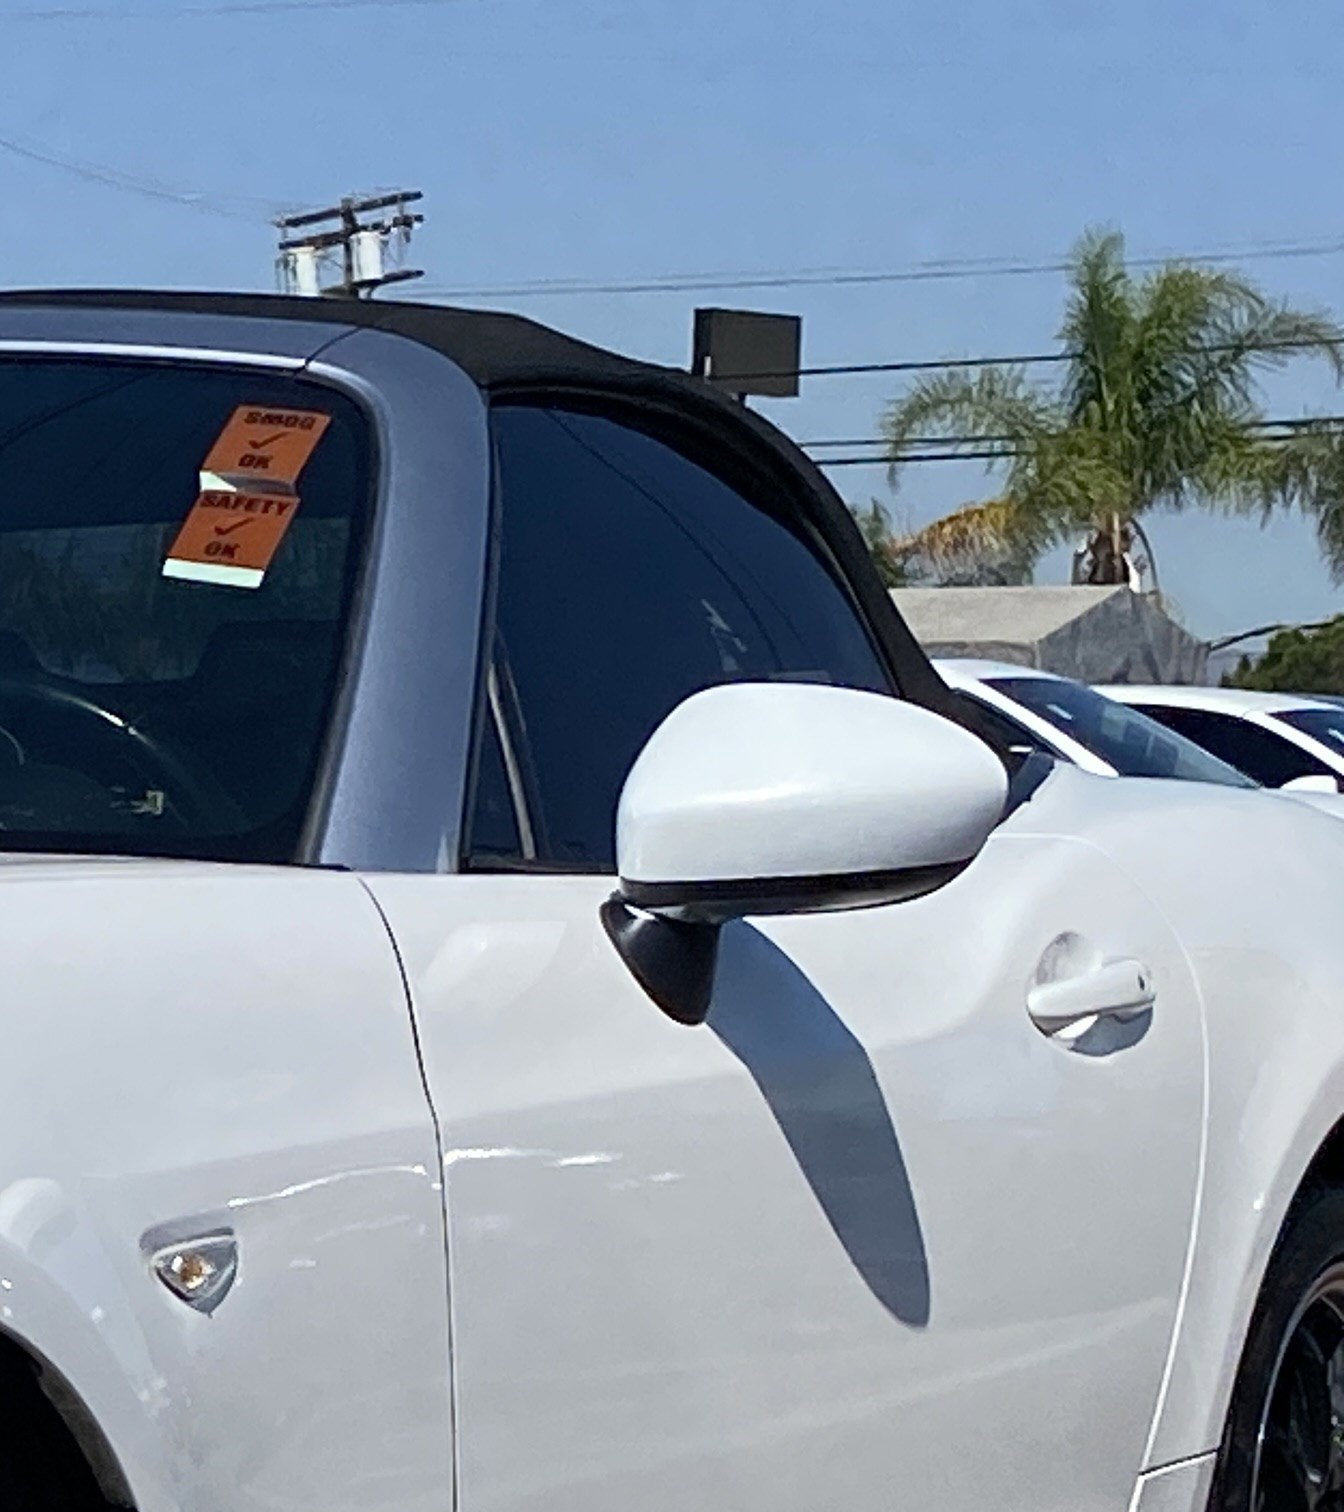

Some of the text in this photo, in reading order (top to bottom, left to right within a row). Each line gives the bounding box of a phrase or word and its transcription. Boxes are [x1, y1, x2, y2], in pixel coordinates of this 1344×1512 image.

[244, 412, 316, 430] SMOG
[238, 454, 273, 470] OK
[201, 494, 289, 516] SAFETY
[204, 541, 240, 558] OK
